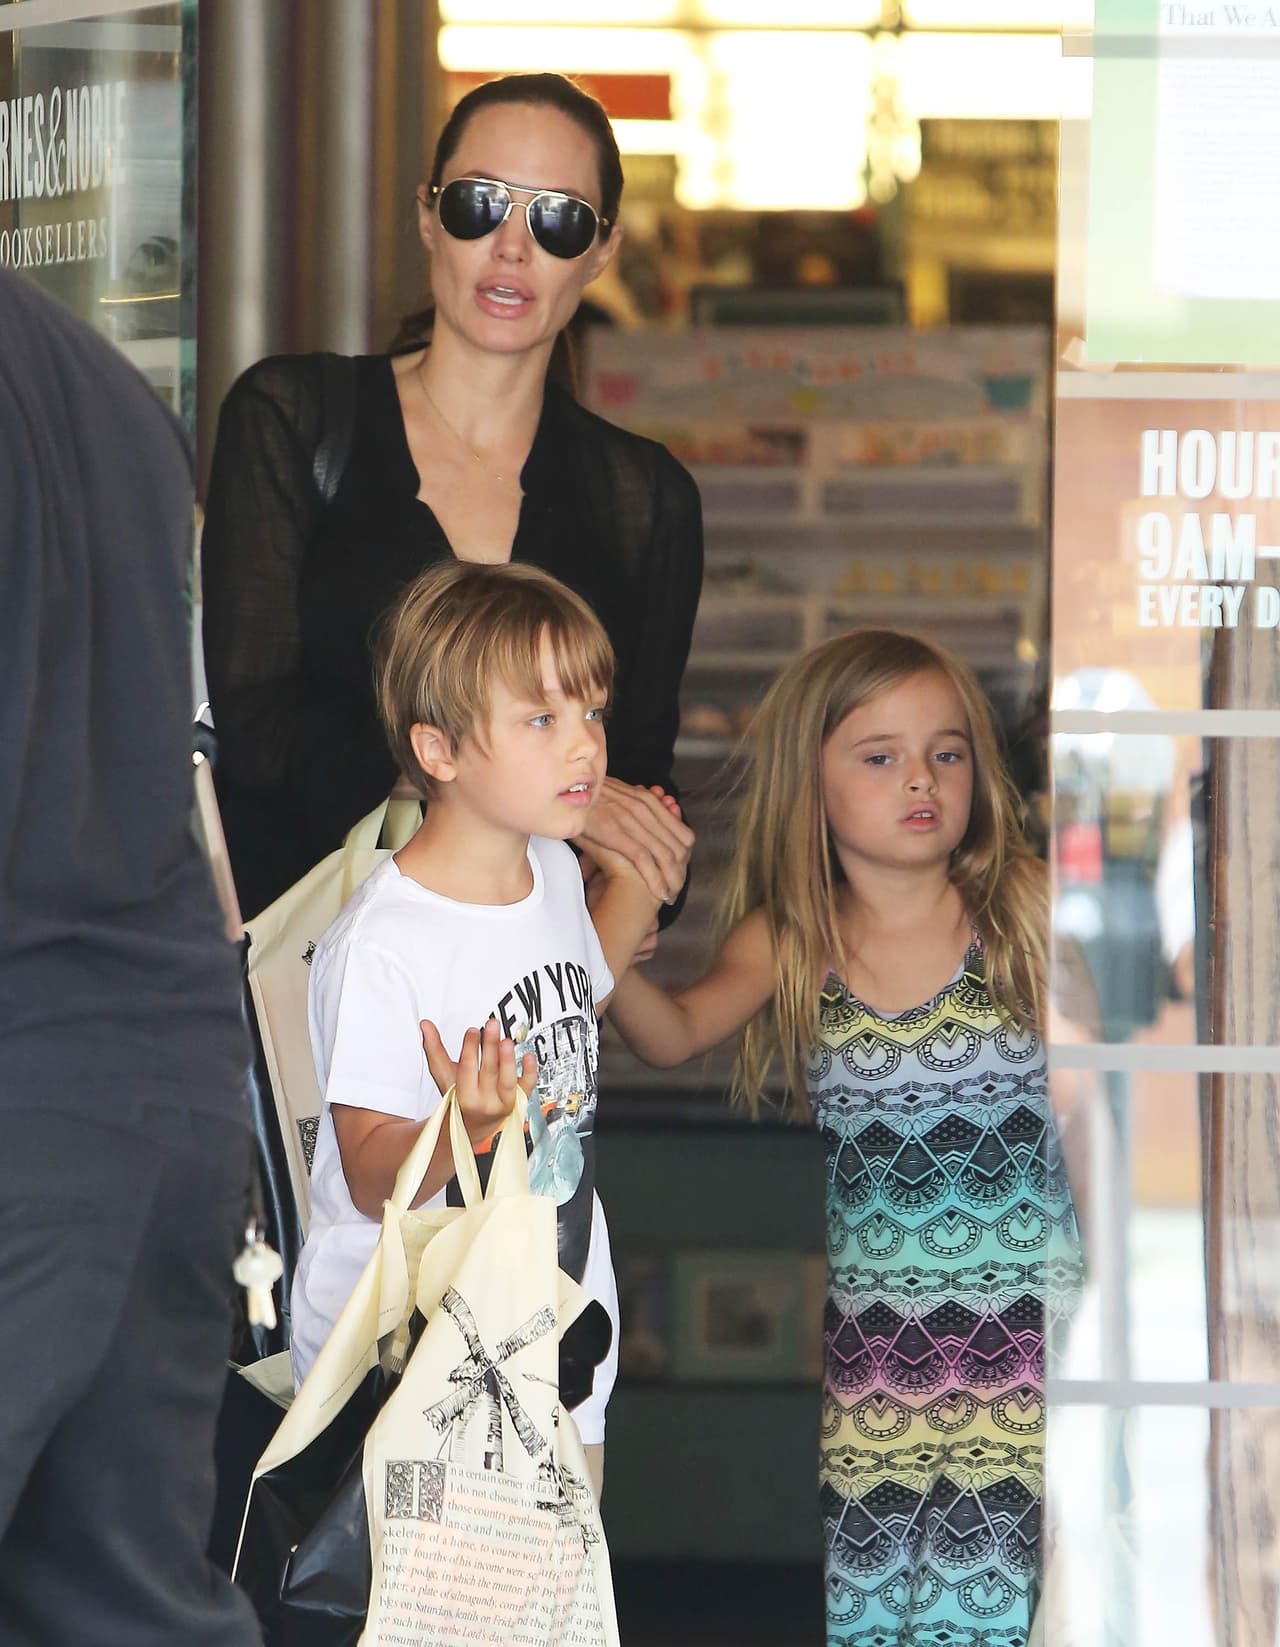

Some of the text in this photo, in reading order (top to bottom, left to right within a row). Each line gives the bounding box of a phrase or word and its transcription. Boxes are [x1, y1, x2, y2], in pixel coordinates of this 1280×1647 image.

[1164, 4, 1216, 26] That
[1223, 4, 1255, 25] We
[1141, 430, 1280, 499] HOUR
[1138, 584, 1246, 628] EVERY
[466, 1469, 497, 1485] certain
[498, 1476, 523, 1490] corner
[457, 1482, 469, 1495] do
[472, 1488, 487, 1500] not
[489, 1490, 518, 1506] choose
[521, 1498, 531, 1508] to
[448, 1499, 473, 1514] those
[473, 1507, 508, 1522] country
[445, 1515, 471, 1532] lance
[473, 1522, 492, 1537] and
[383, 1525, 426, 1543] skeleton
[429, 1533, 440, 1544] of
[480, 1543, 490, 1553] to
[491, 1547, 521, 1560] course
[523, 1551, 543, 1565] with
[414, 1548, 447, 1563] fourths
[449, 1552, 460, 1566] of
[459, 1555, 472, 1567] his
[473, 1560, 504, 1574] income
[506, 1567, 525, 1578] were
[418, 1582, 439, 1598] plate
[439, 1591, 450, 1601] of
[441, 1570, 452, 1583] in
[452, 1572, 476, 1586] which
[477, 1576, 491, 1589] the
[492, 1580, 524, 1595] mutton
[393, 1616, 413, 1629] such
[401, 1601, 412, 1611] on
[455, 1608, 479, 1622] lentils
[480, 1615, 491, 1624] on
